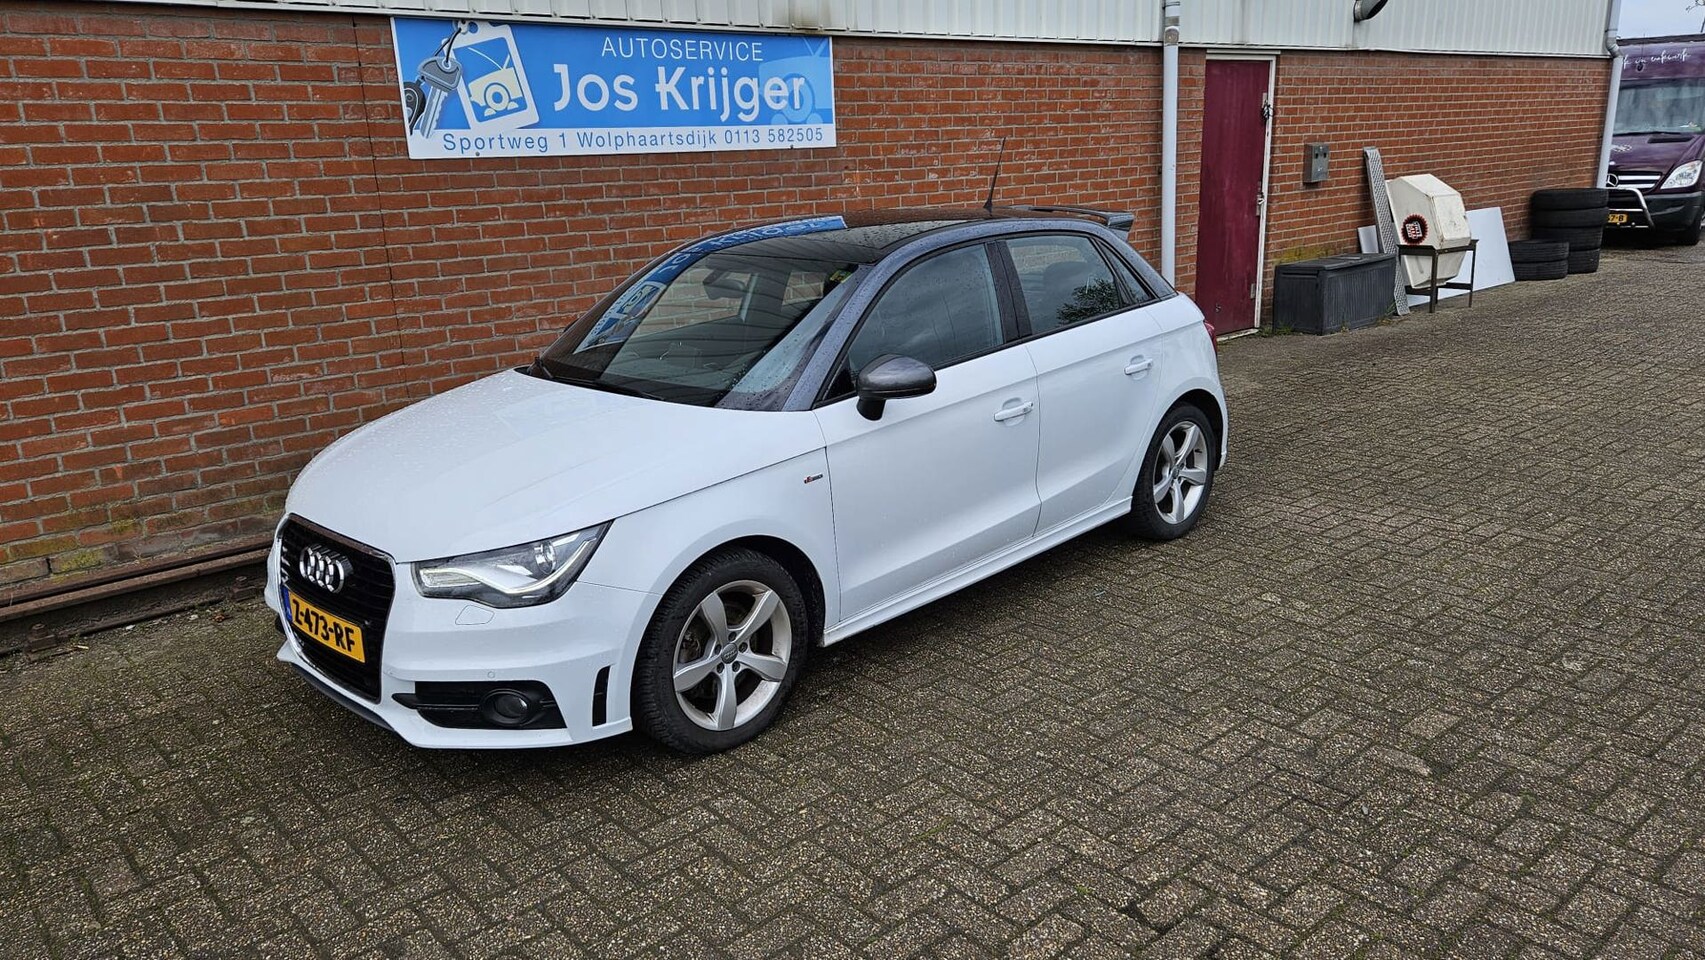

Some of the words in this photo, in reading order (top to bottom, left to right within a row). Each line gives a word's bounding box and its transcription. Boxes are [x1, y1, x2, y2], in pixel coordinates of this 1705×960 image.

[601, 36, 764, 62] AUTOSERVICE
[553, 63, 639, 112] Jos
[654, 66, 805, 123] Krijger
[443, 132, 549, 154] Sportweg
[558, 132, 567, 149] 1
[576, 130, 717, 151] Wolphaartsdijk
[724, 129, 761, 145] 0113
[768, 127, 823, 143] 582505
[292, 598, 355, 653] Z-473-RF
